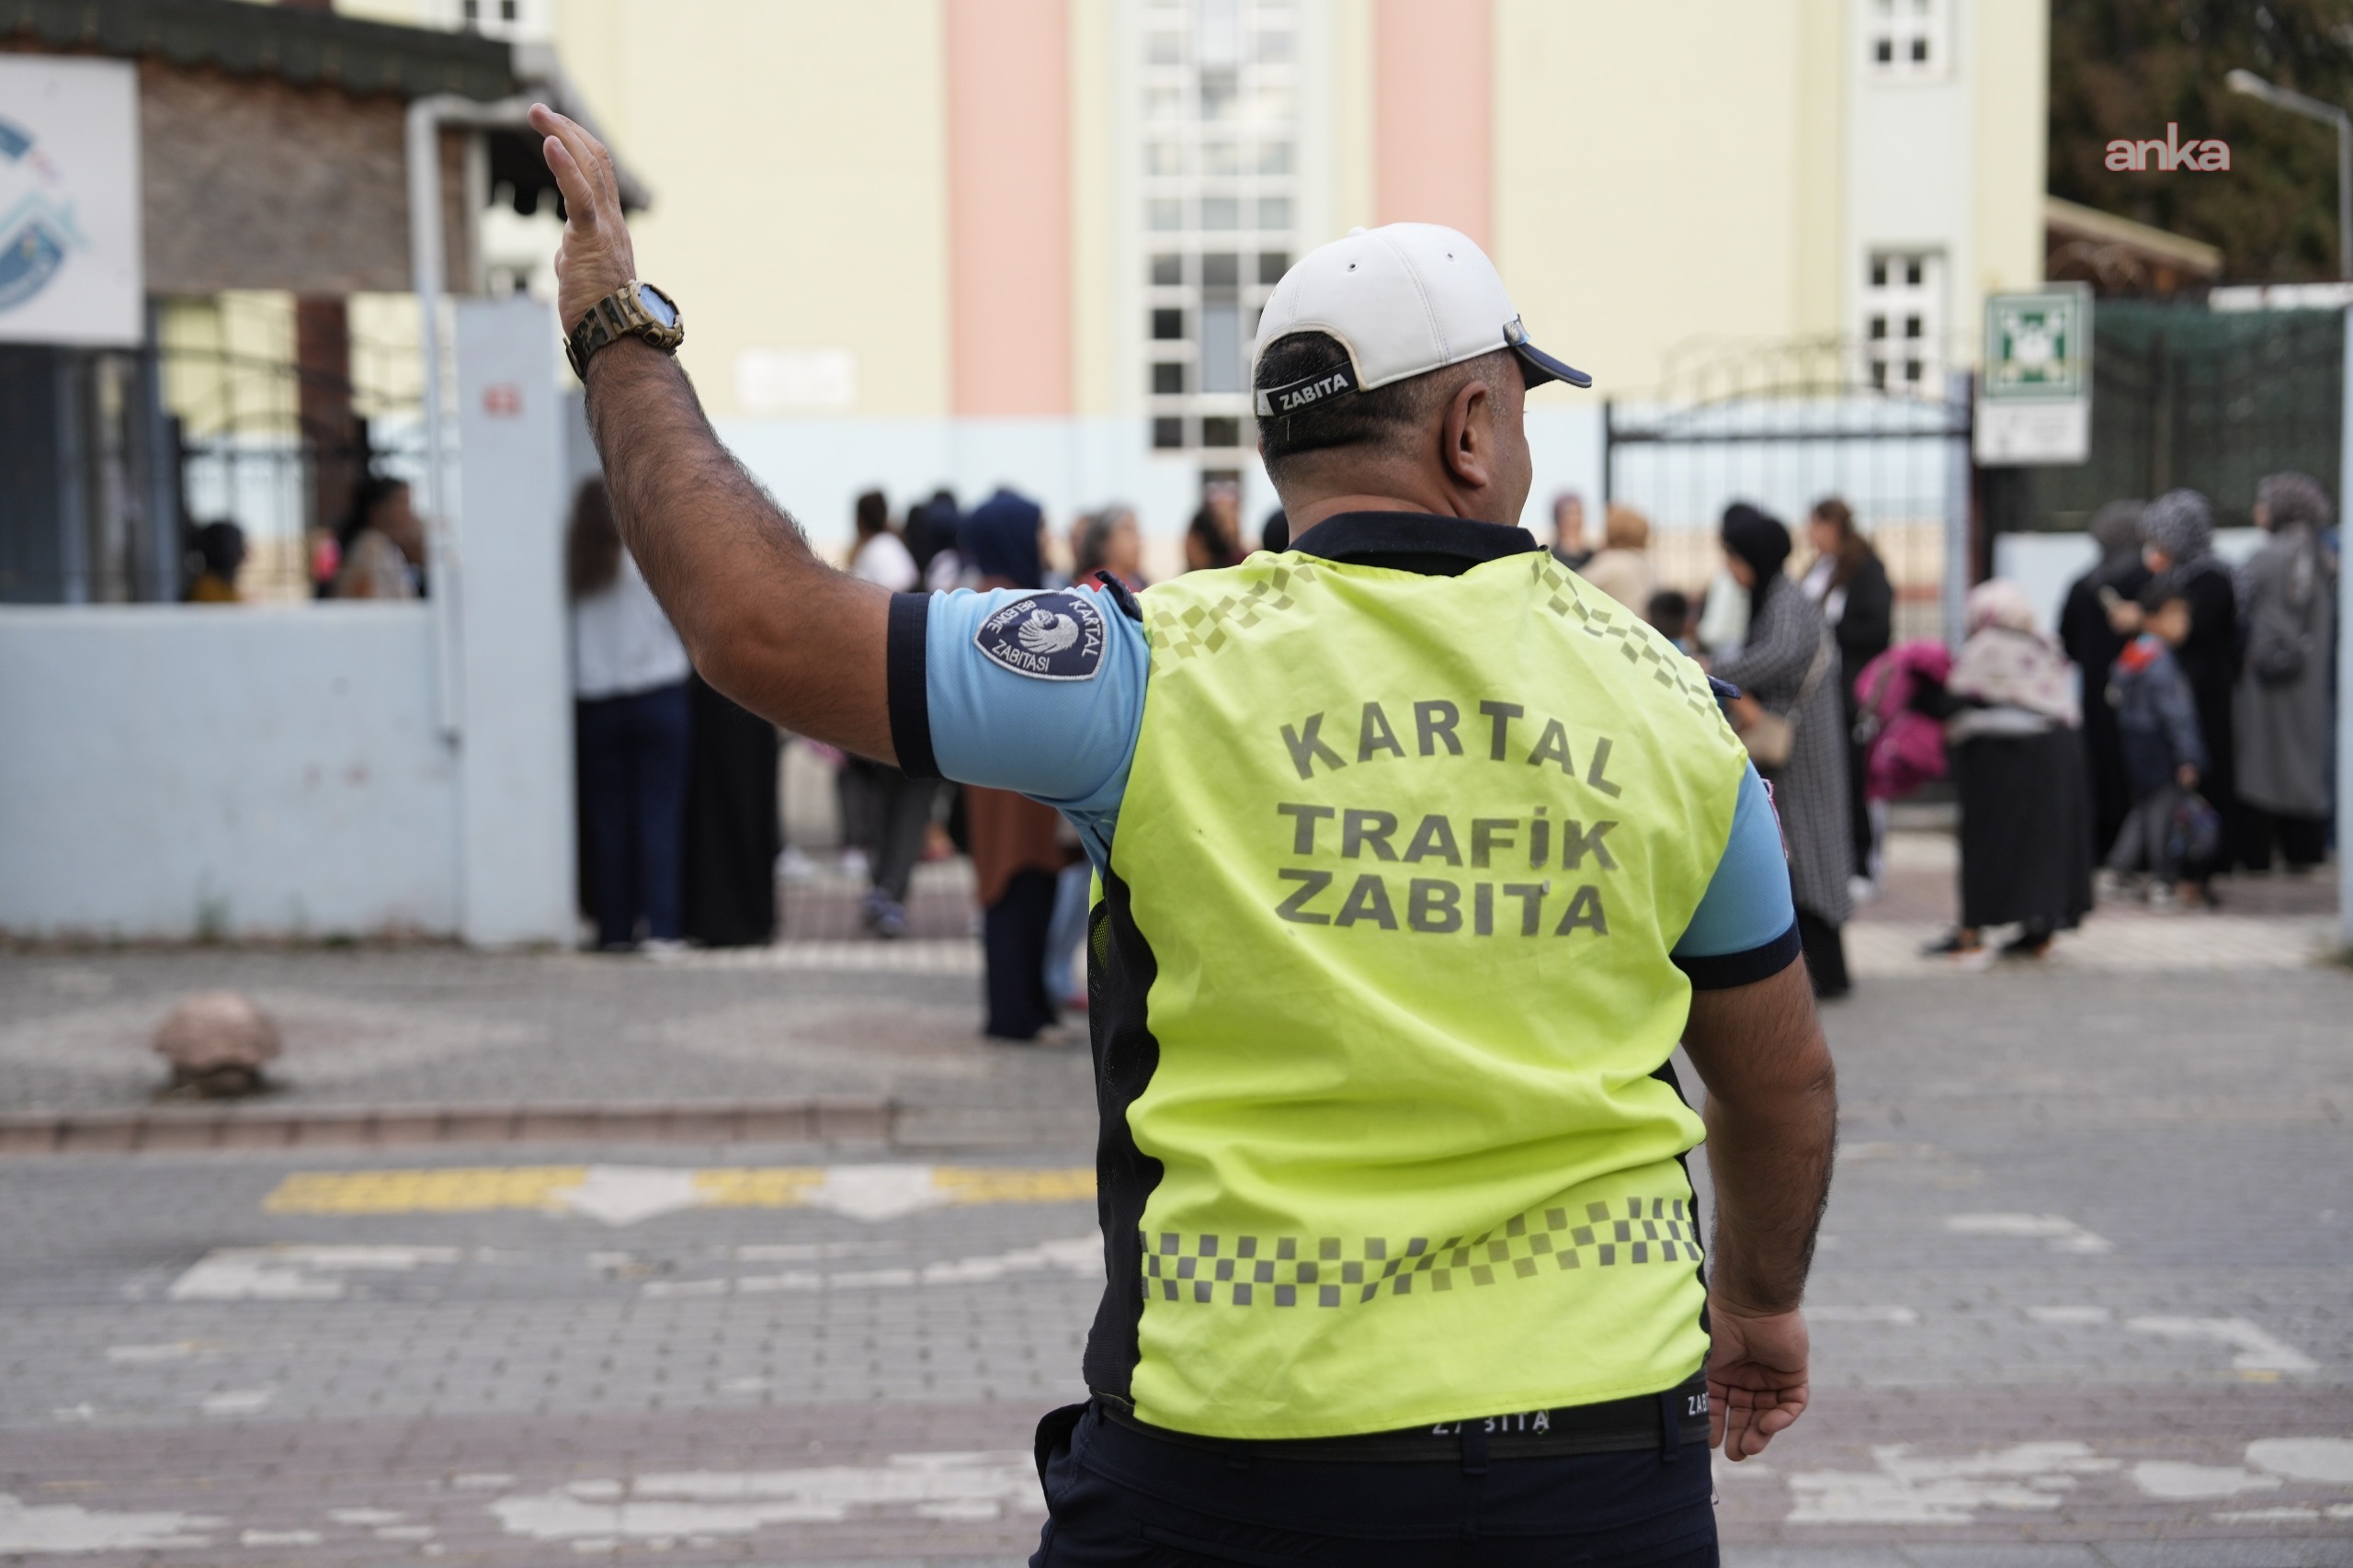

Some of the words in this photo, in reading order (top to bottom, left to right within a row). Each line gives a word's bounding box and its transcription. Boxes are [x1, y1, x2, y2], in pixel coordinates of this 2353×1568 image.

[1279, 372, 1349, 411] ZABITA
[992, 639, 1051, 673] ZABITASI
[1068, 599, 1102, 658] KARTAL
[1279, 699, 1622, 800] KARTAL
[1277, 801, 1620, 870] TRAFİK
[1275, 868, 1609, 937] ZABITA
